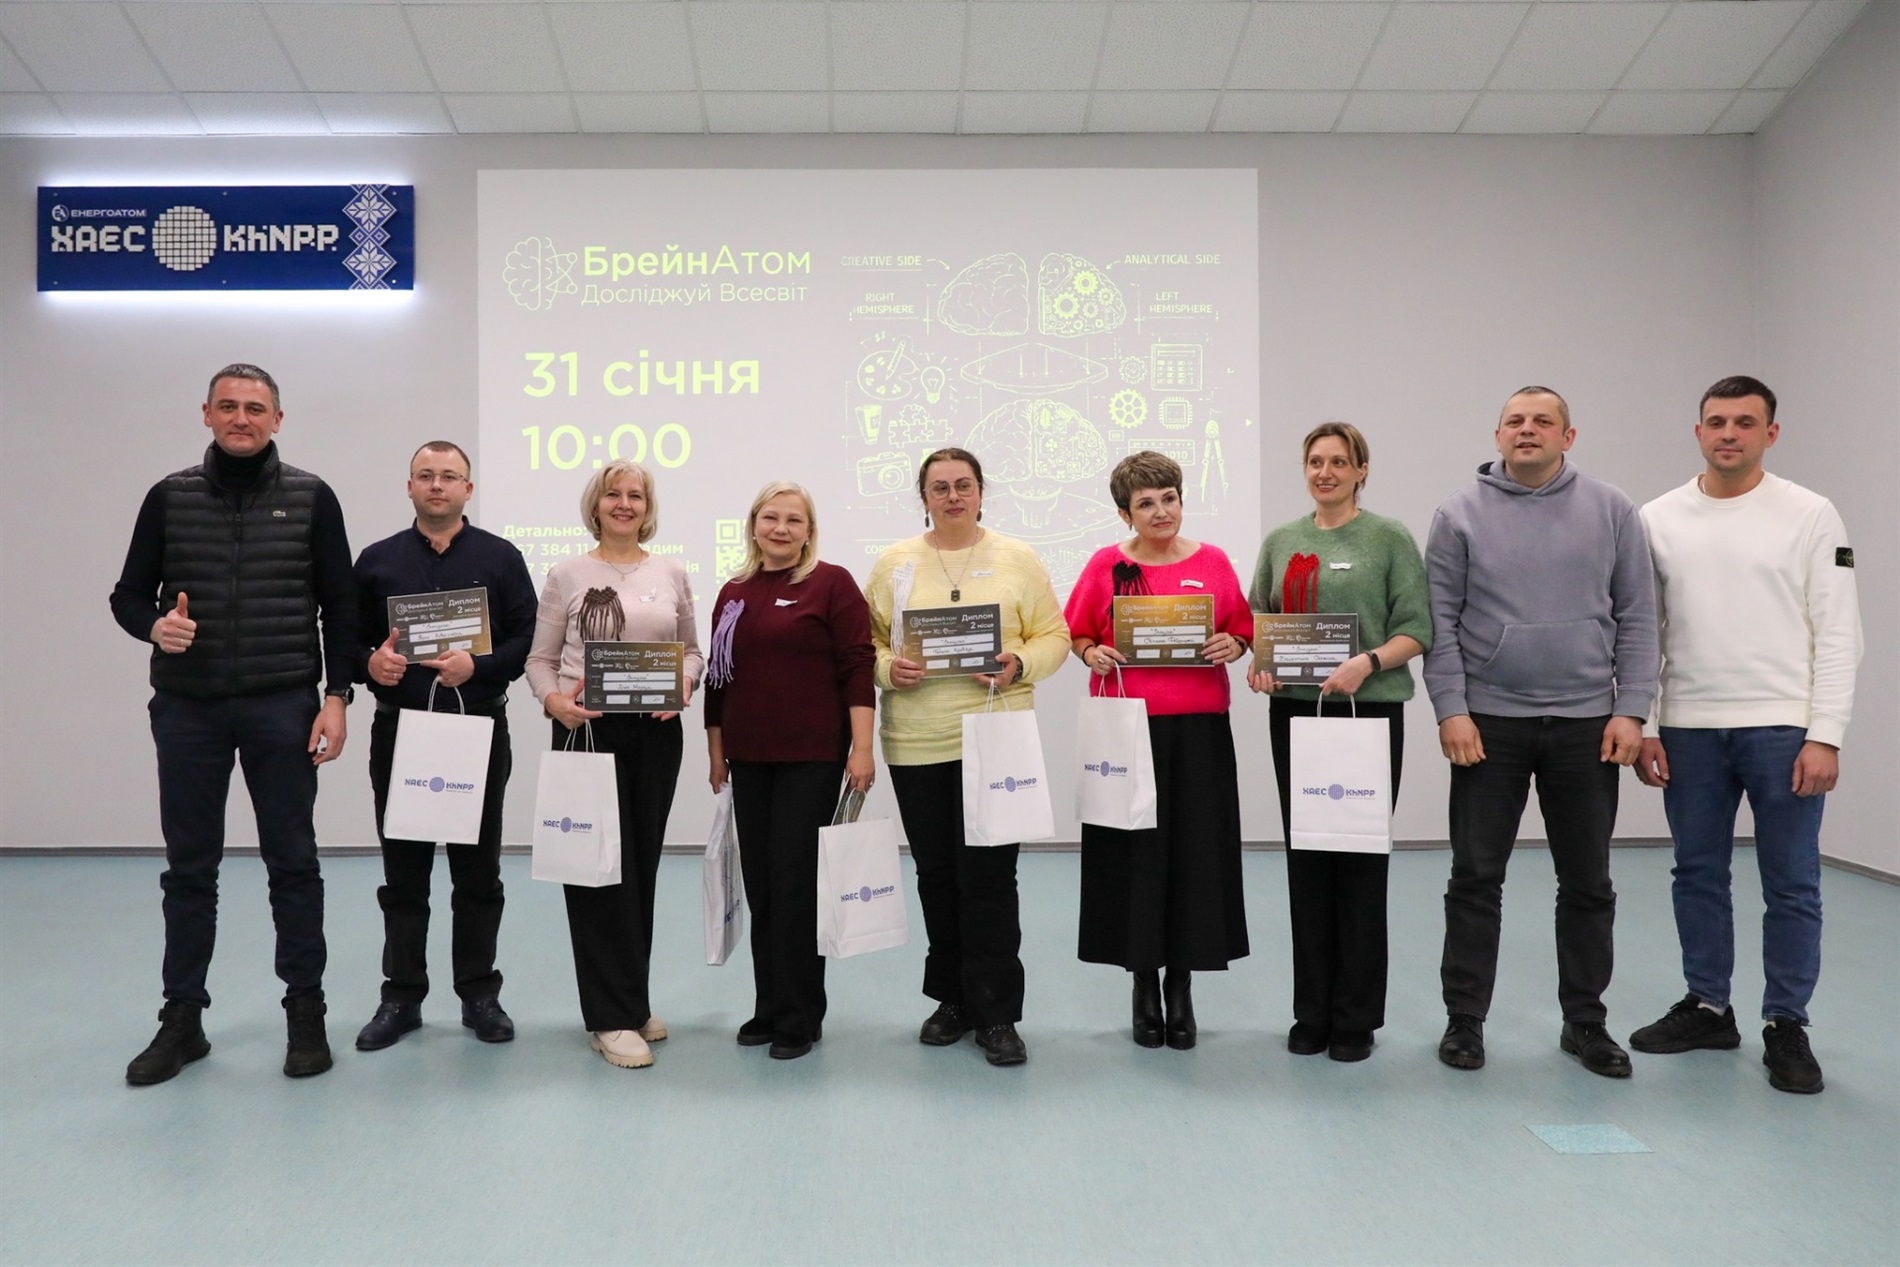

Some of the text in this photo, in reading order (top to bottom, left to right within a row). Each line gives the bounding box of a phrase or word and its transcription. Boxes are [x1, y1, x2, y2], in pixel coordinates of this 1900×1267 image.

[71, 209, 147, 217] ЕНЕРГОАТОМ
[584, 244, 811, 281] БрейнАтом
[840, 255, 922, 266] CREATIVE SIDE
[1124, 254, 1221, 265] ANALYTICAL SIDE
[581, 282, 808, 306] Досліджуй Всесвіт
[865, 292, 895, 302] RIGHT
[1155, 291, 1180, 301] LEFT
[1149, 304, 1213, 313] HEMISPHERE
[523, 350, 759, 397] 31 січня
[521, 423, 691, 470] 10:00
[503, 525, 587, 539] Детально:
[540, 543, 571, 556] 384
[448, 598, 480, 607] Диплом
[457, 606, 463, 614] 2
[961, 613, 994, 622] Диплом
[1182, 612, 1188, 620] 2
[1316, 622, 1351, 630] Диплом
[1325, 631, 1331, 639] 2
[644, 650, 677, 658] Диплом
